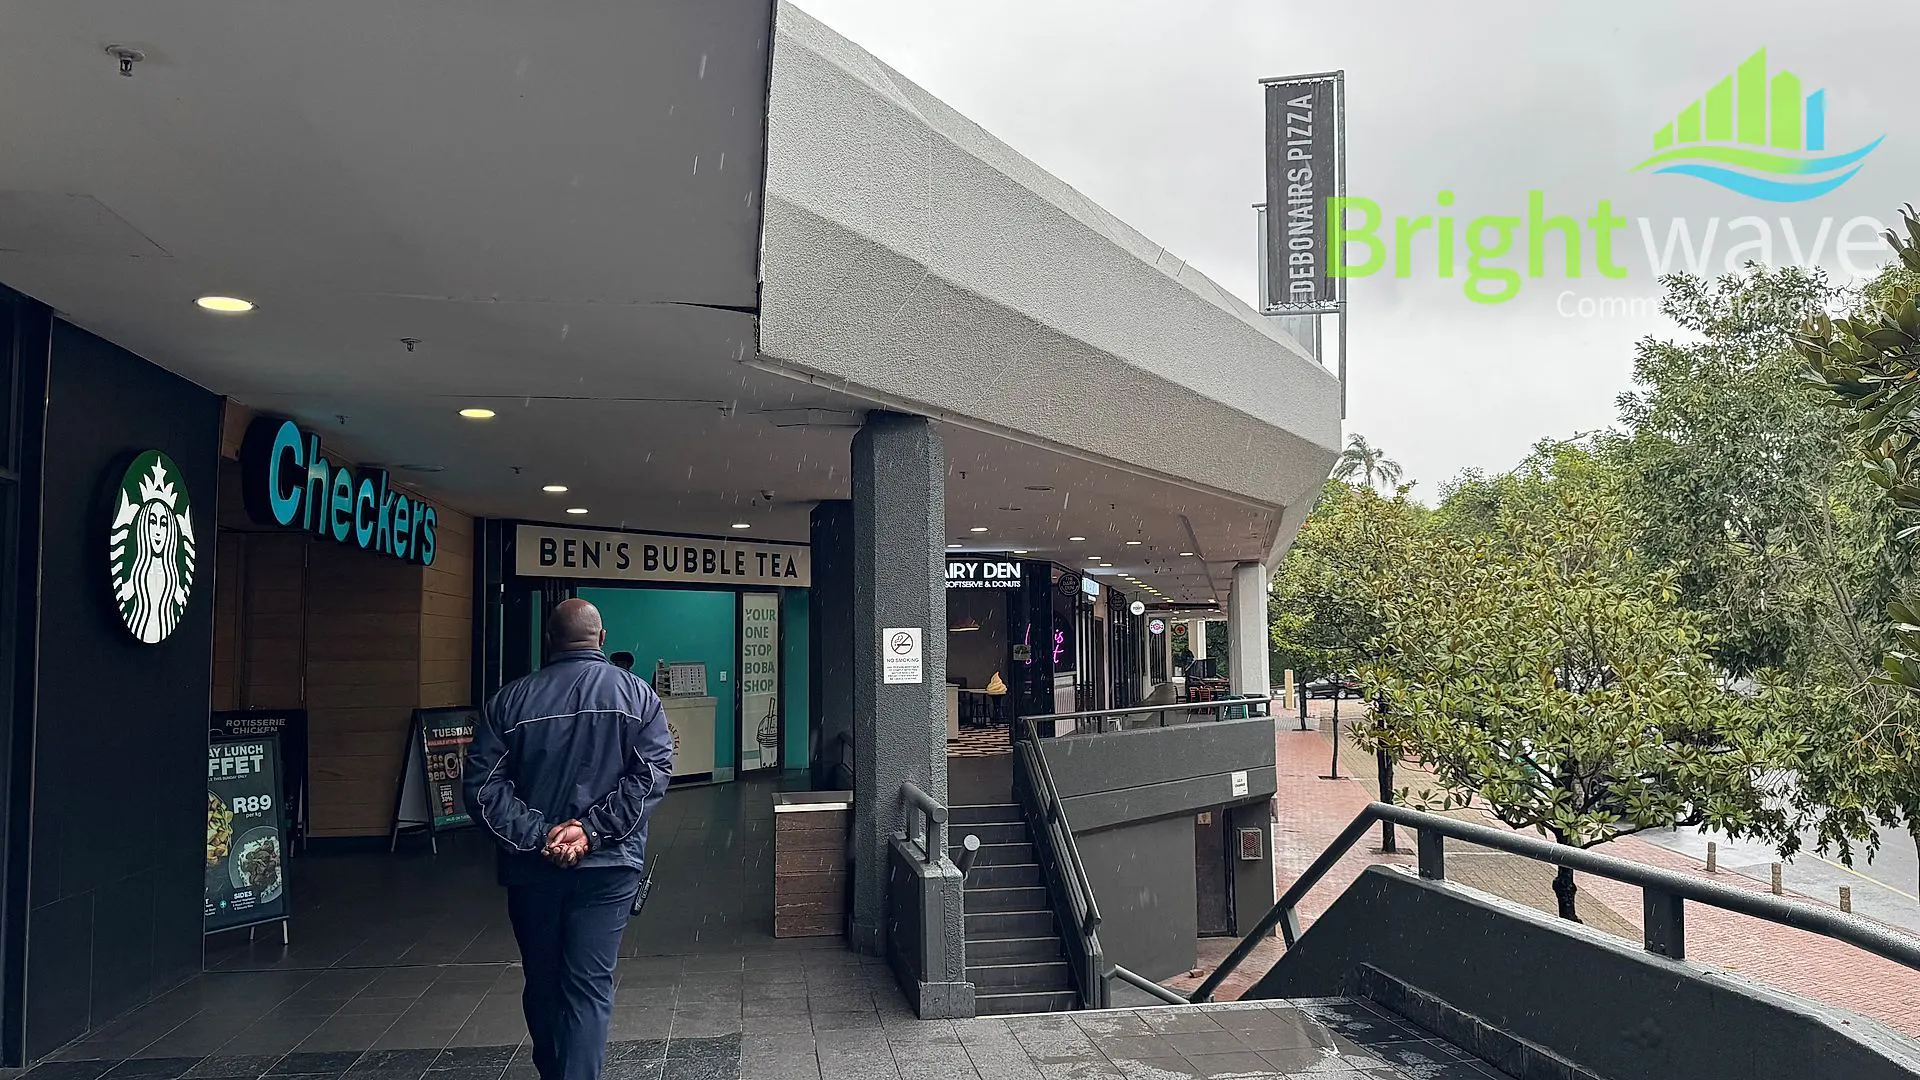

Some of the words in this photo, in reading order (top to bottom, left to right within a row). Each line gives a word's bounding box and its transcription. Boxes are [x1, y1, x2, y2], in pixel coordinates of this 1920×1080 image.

[1287, 93, 1313, 161] PIZZA
[1288, 167, 1315, 294] DEBONAIRS
[269, 420, 437, 566] Checkers
[540, 538, 630, 570] BEN'S
[643, 545, 745, 576] BUBBLE
[755, 552, 798, 578] TEA
[984, 562, 1021, 579] DEN
[745, 609, 776, 621] YOUR
[745, 627, 769, 639] ONE
[744, 644, 772, 657] STOP
[744, 662, 775, 674] BOBA
[744, 679, 774, 692] SHOP
[225, 719, 286, 727] ROTISSERIE
[232, 727, 278, 735] CHICKEN
[432, 726, 473, 738] TUESDAY
[224, 745, 263, 757] LUNCH
[233, 795, 272, 814] R89
[233, 891, 253, 900] SIDES
